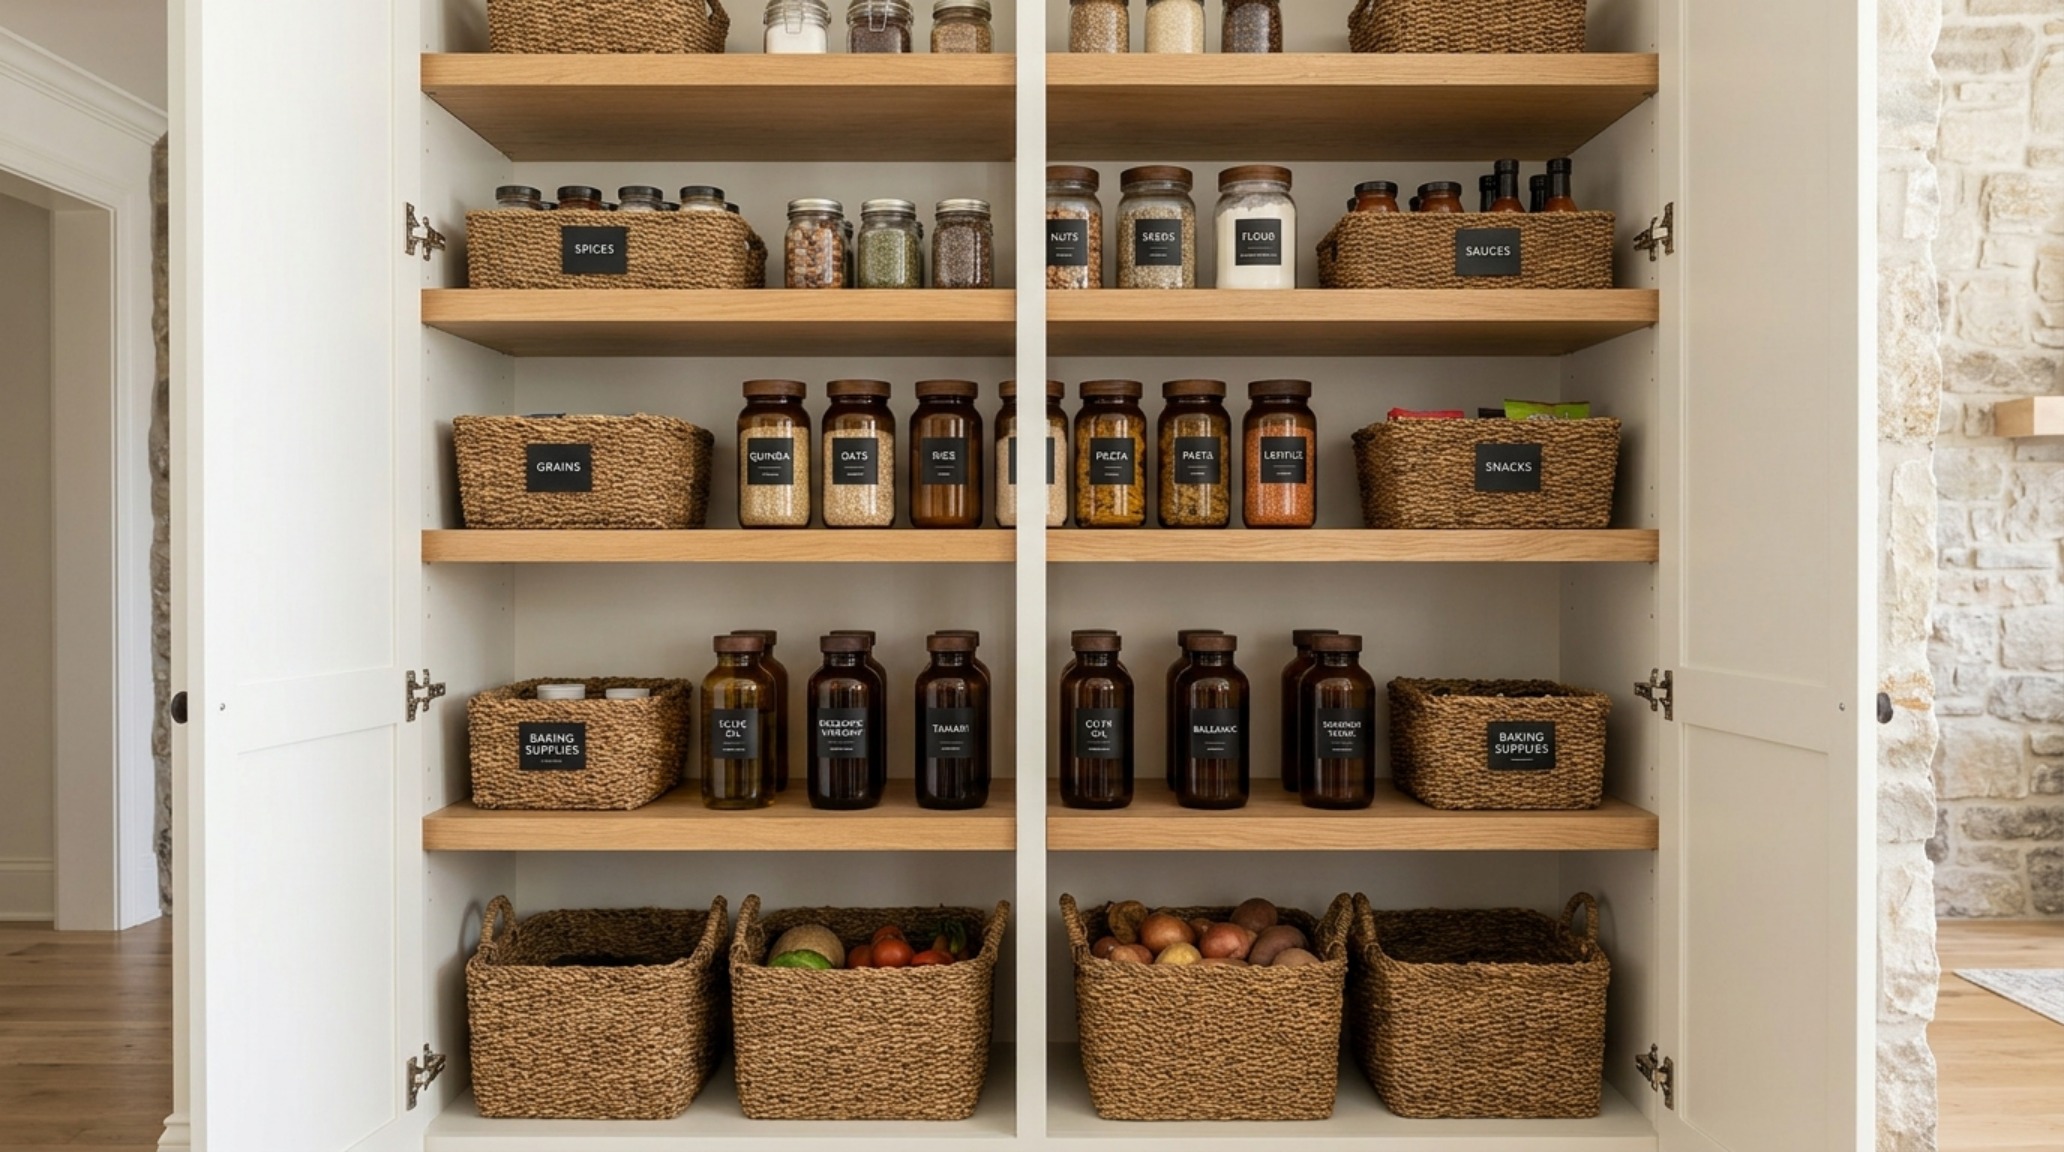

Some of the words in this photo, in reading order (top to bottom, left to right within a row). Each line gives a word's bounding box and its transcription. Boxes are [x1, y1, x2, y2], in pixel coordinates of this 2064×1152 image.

[1051, 232, 1080, 242] NUTS
[574, 244, 615, 255] SPICES
[1465, 246, 1511, 256] SAUCES
[841, 451, 869, 461] OATS
[536, 462, 582, 472] GRAINS
[1485, 462, 1533, 472] SNACKS
[1499, 732, 1545, 742] BAKING
[525, 745, 580, 755] SUPPLIES
